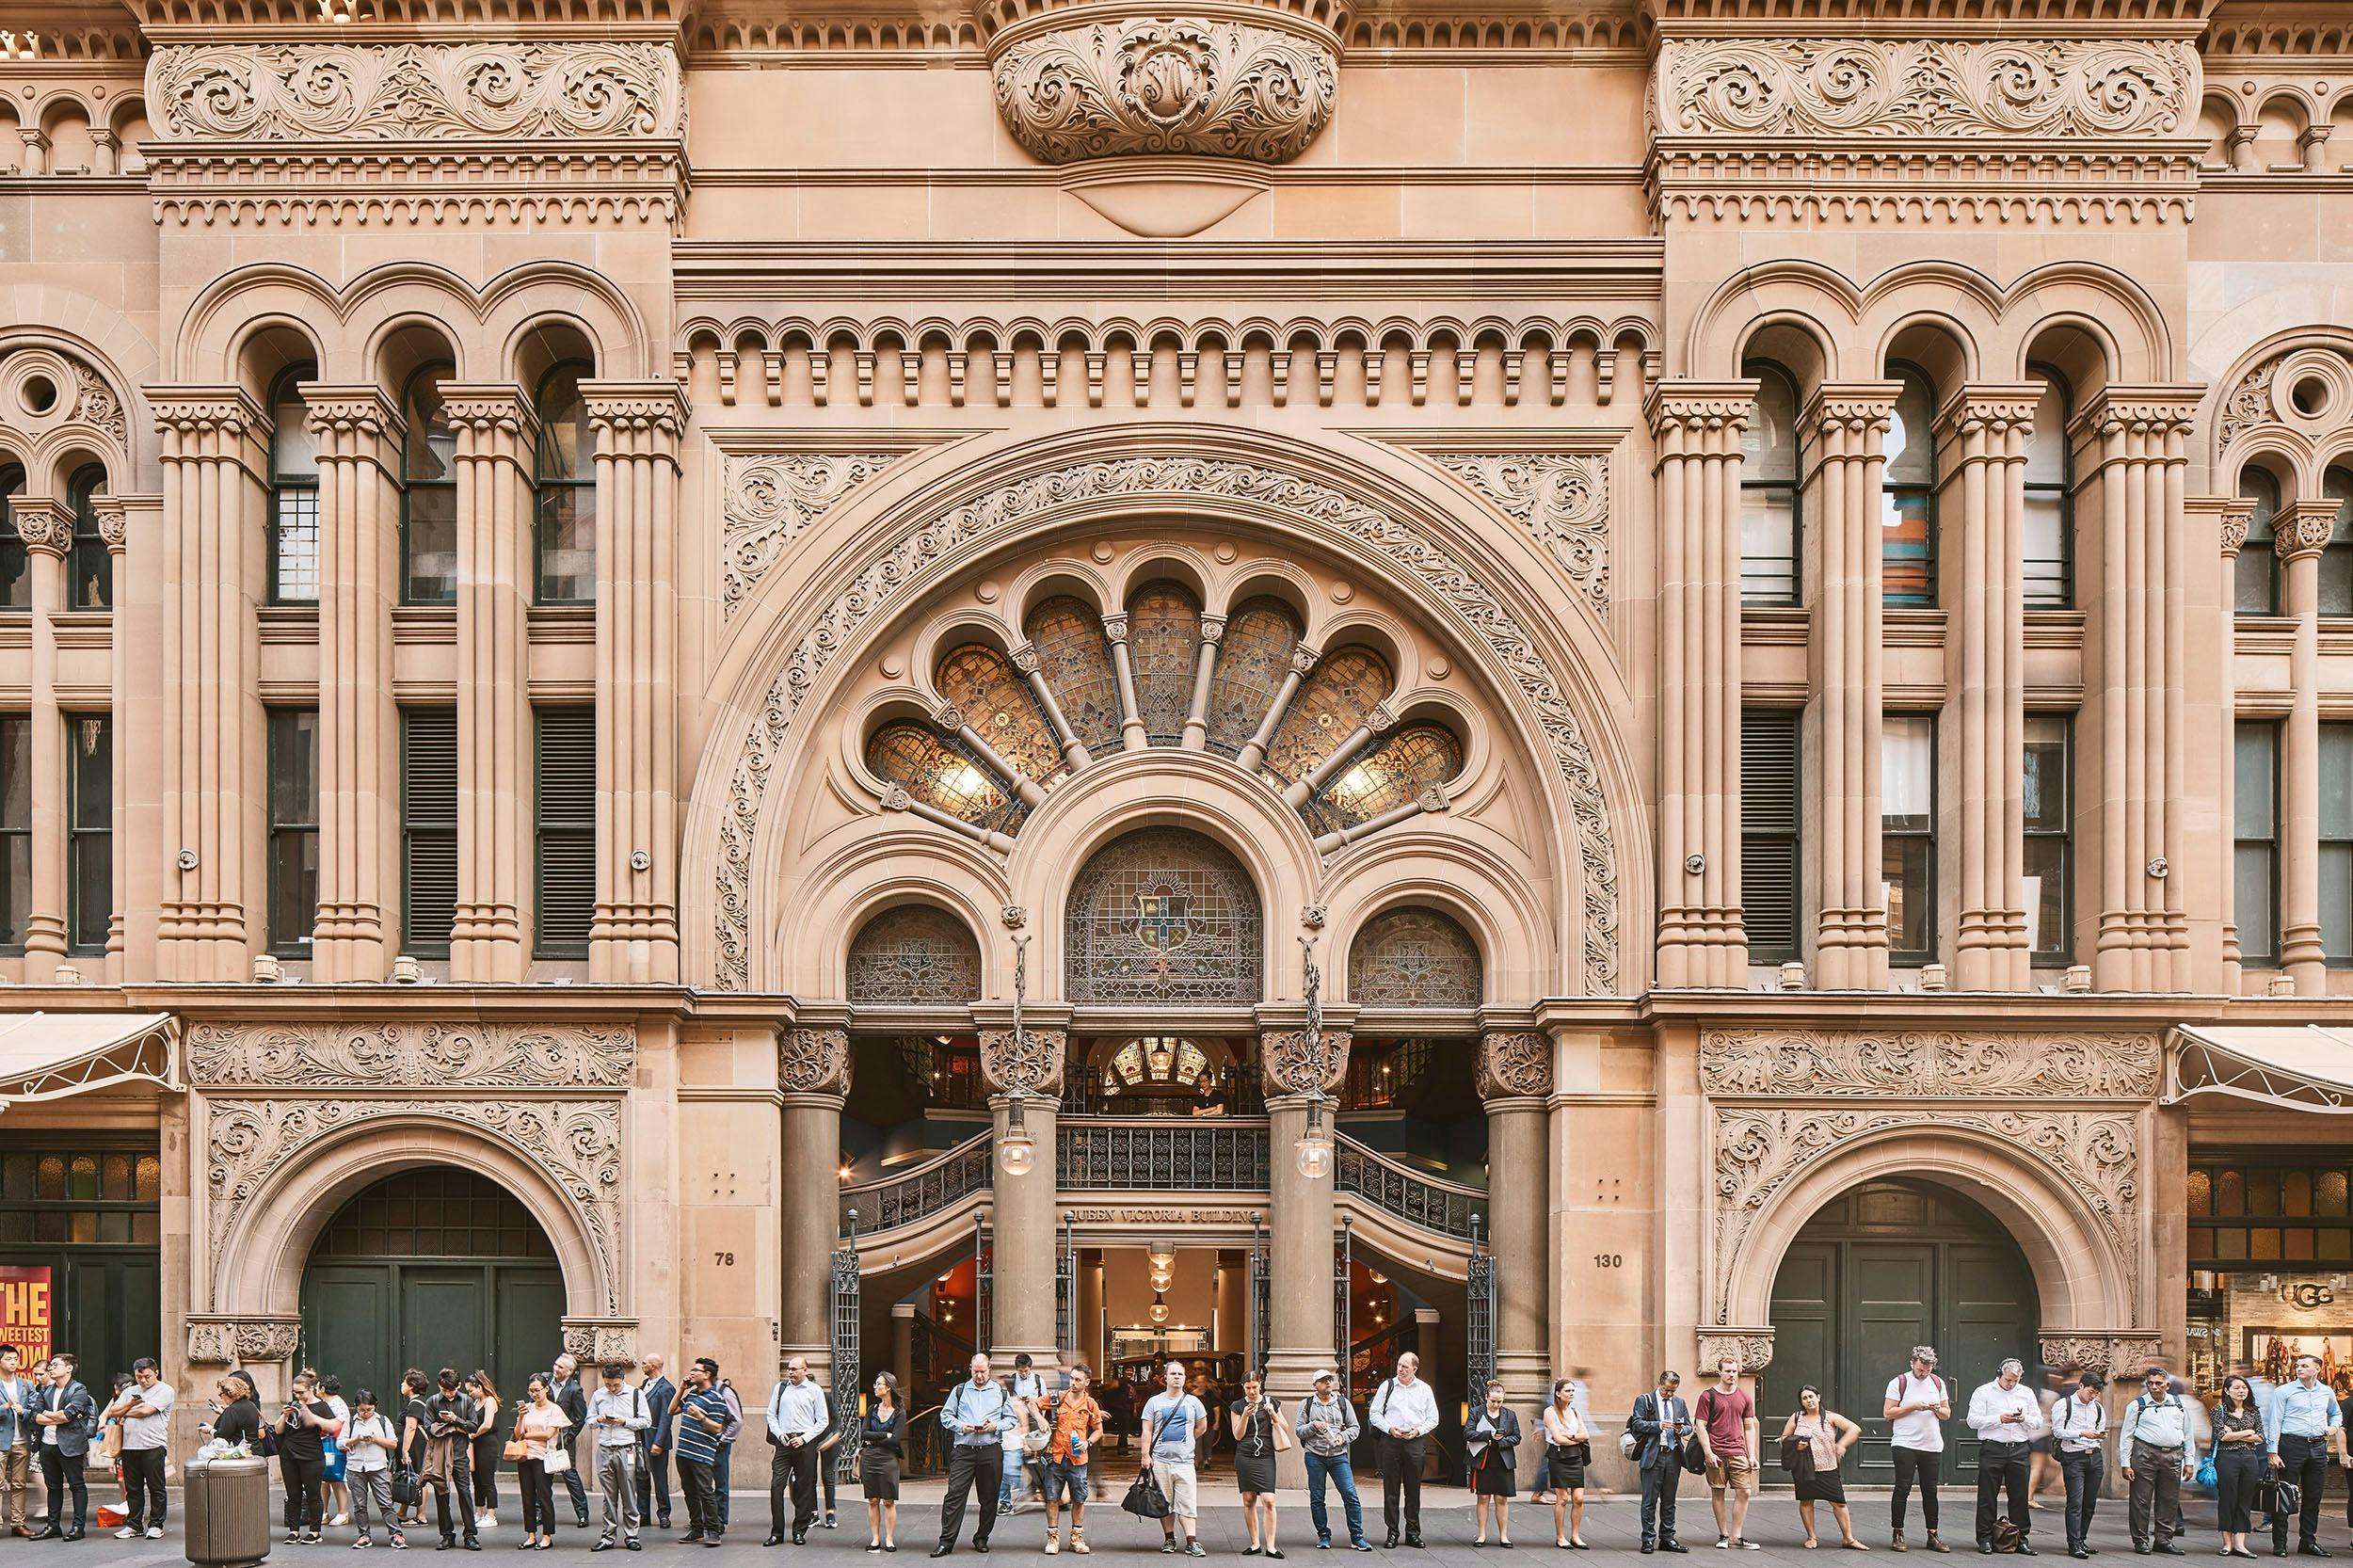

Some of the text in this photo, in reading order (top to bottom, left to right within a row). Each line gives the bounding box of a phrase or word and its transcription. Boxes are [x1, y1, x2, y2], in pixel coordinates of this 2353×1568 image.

[1121, 1209, 1185, 1222] VICTORIA
[715, 1252, 734, 1266] 78
[1593, 1254, 1622, 1268] 130
[2281, 1284, 2334, 1307] UGG
